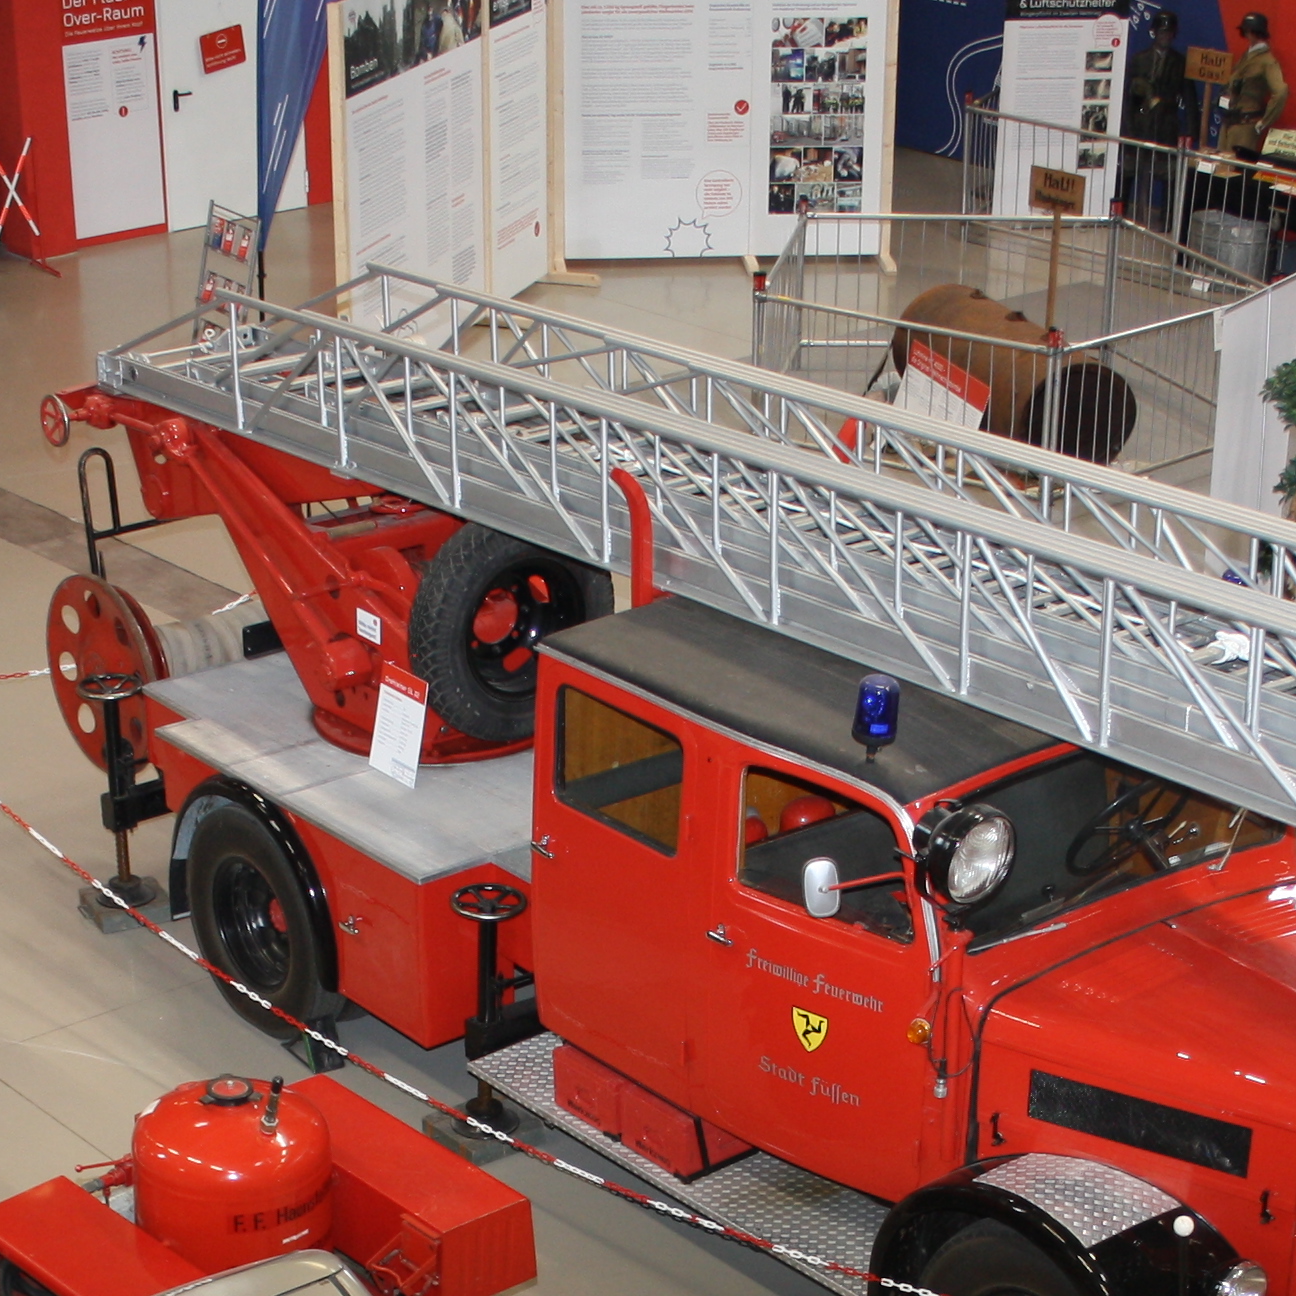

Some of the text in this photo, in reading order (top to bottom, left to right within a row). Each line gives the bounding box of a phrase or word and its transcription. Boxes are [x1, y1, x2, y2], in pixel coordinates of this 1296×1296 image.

[63, 6, 145, 28] Over-Raum
[746, 948, 884, 1013] Freiwillige Feuerwehr
[758, 1056, 805, 1087] Stadt
